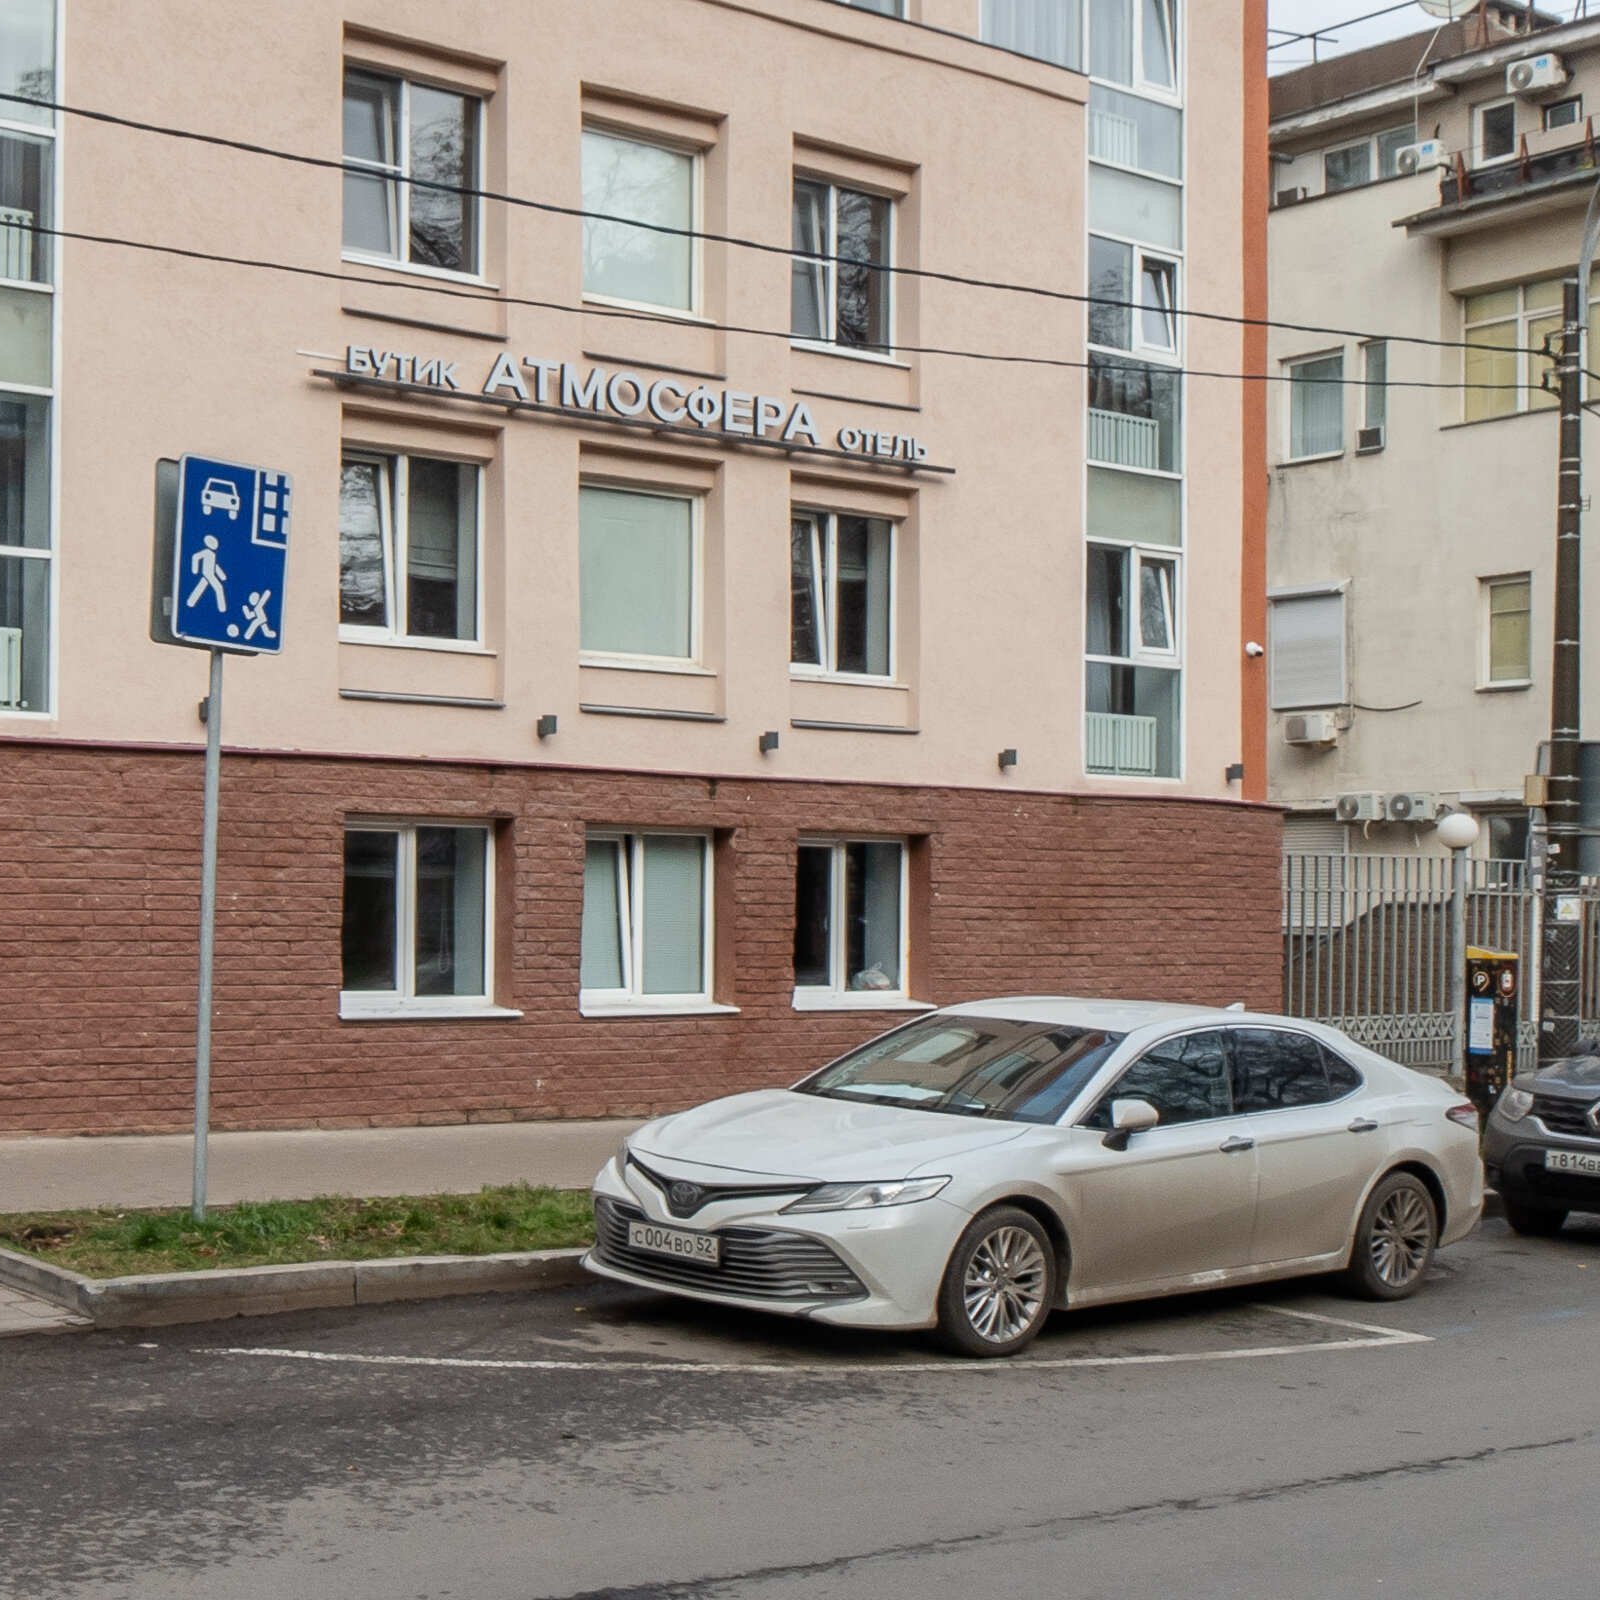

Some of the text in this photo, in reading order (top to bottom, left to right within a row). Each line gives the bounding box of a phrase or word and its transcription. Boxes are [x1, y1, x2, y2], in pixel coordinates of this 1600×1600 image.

[347, 345, 928, 461] БУТИК АТМОСФЕРА ОТЕЛЬ
[634, 1228, 713, 1254] С004ВО 52
